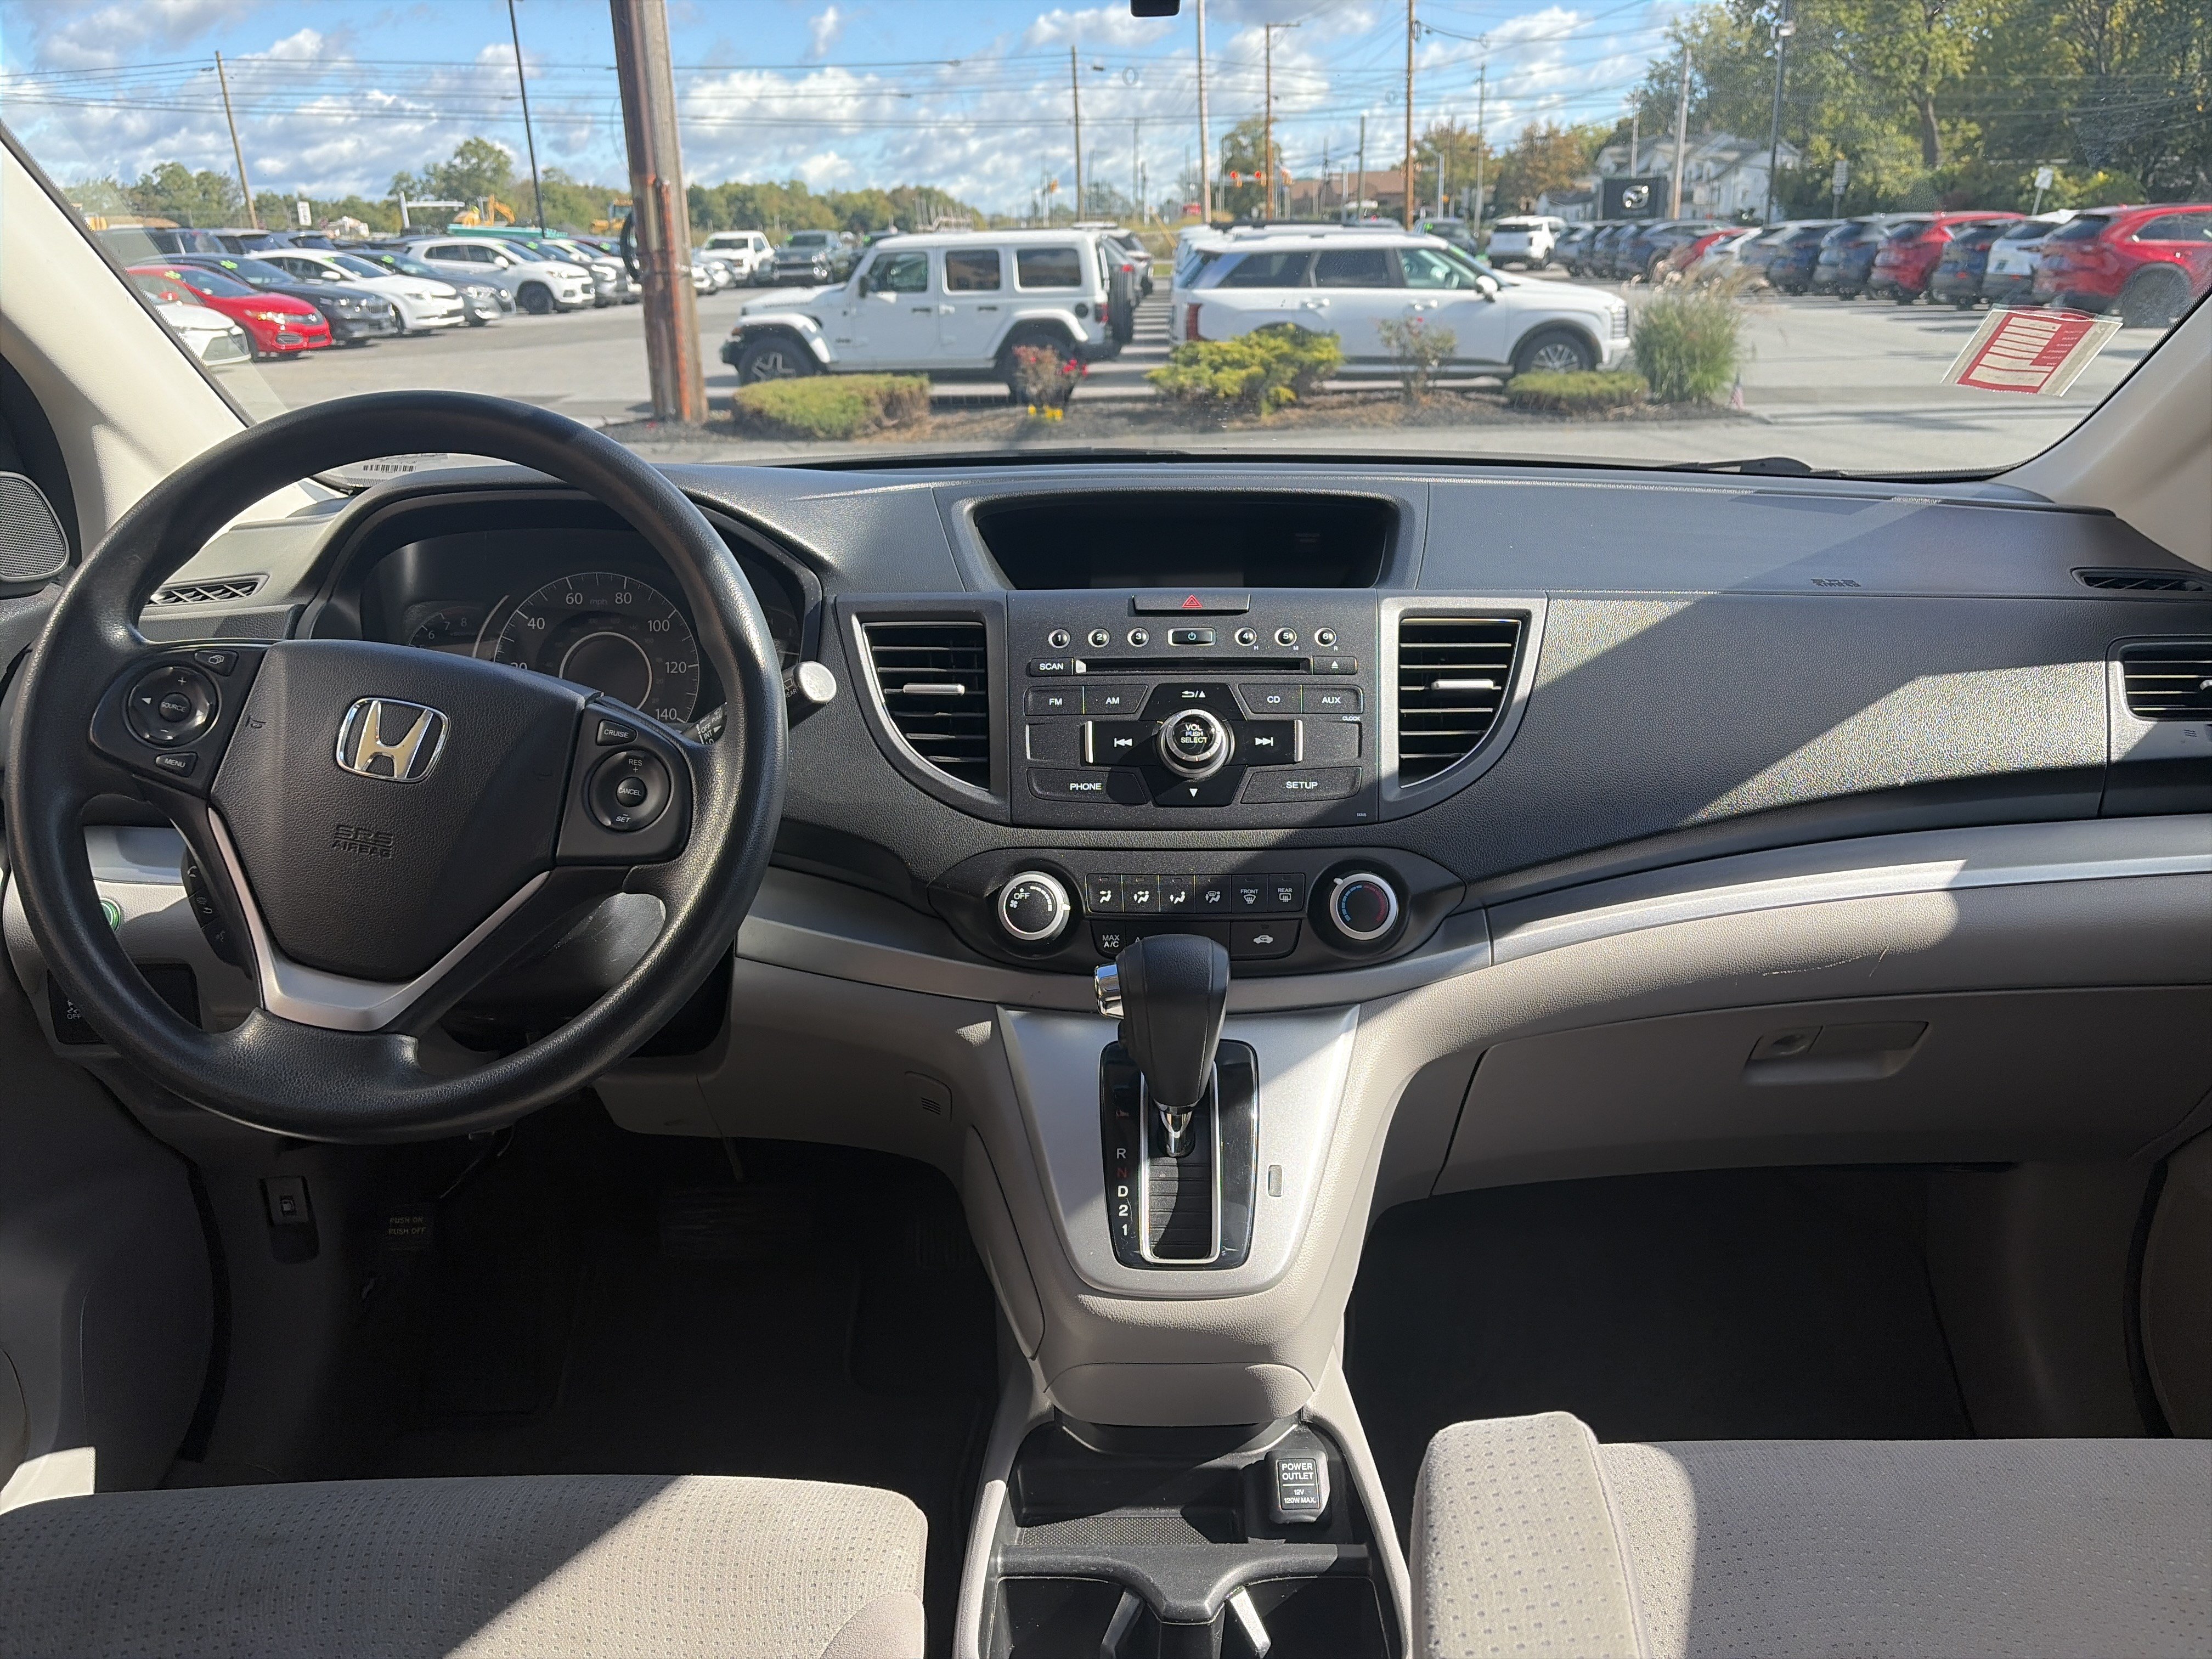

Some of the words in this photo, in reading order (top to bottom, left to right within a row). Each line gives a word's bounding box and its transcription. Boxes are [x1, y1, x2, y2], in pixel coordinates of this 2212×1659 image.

[566, 592, 583, 605] 60
[590, 598, 607, 606] mph
[615, 592, 632, 605] 80
[443, 621, 451, 631] 7
[460, 617, 467, 628] 8
[527, 617, 545, 630] 40
[648, 619, 670, 632] 100
[428, 630, 435, 640] 6
[665, 661, 687, 674] 120
[161, 702, 185, 712] SOURCE
[656, 708, 677, 721] 140
[701, 722, 712, 733] OFF
[604, 729, 629, 738] CRUISE
[703, 729, 713, 740] INT
[165, 758, 185, 767] MENU
[628, 758, 642, 767] RES
[617, 788, 641, 796] CANCEL
[335, 824, 394, 845] SRS
[331, 840, 392, 859] AIRBAG
[1117, 1148, 1126, 1159] R
[1118, 1168, 1127, 1178] N
[1118, 1186, 1128, 1197] D
[1119, 1204, 1128, 1216] 2
[1122, 1224, 1127, 1236] 1
[1282, 1463, 1313, 1471] POWER
[1282, 1472, 1314, 1481] OUTLET
